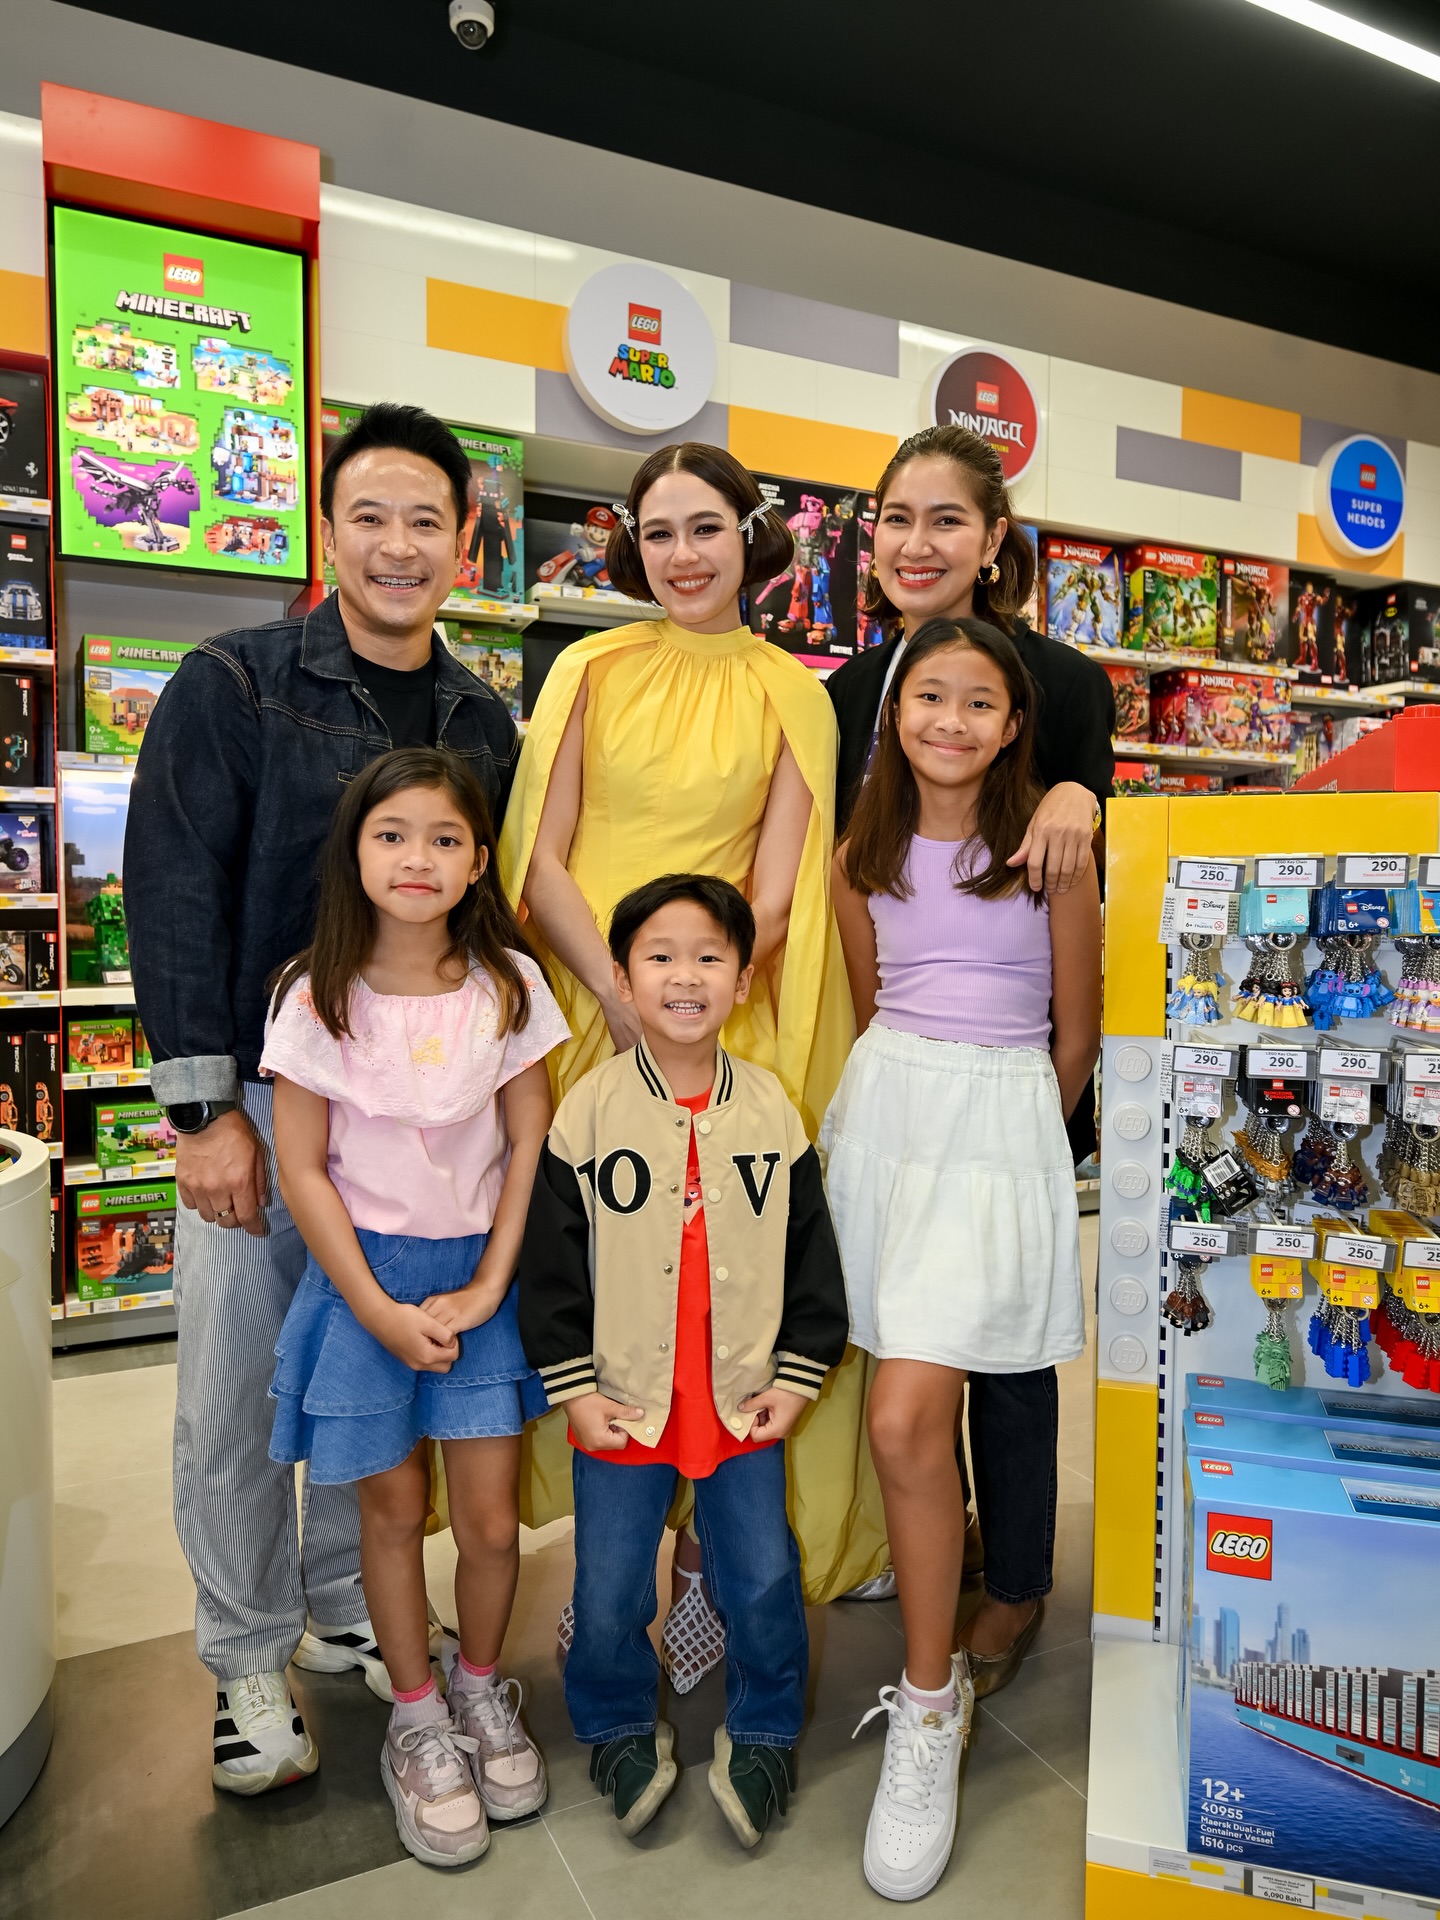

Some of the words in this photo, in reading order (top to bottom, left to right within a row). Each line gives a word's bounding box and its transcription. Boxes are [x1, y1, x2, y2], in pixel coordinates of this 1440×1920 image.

[167, 266, 200, 284] LEGO
[115, 290, 251, 333] MINECRAFT
[632, 315, 659, 332] LEGO
[618, 344, 669, 368] SUPER
[608, 356, 676, 389] MARIO
[978, 391, 998, 404] LEGO
[948, 408, 1026, 448] NINJAGO
[1361, 471, 1376, 482] LEGO
[1352, 498, 1382, 514] SUPER
[1347, 512, 1385, 529] HEROES
[1064, 544, 1102, 564] NINJAGO
[1158, 551, 1196, 569] NINJAGO
[1236, 562, 1269, 580] NINJAGO
[90, 645, 110, 655] LEGO
[116, 646, 186, 662] MINECRAF
[1200, 674, 1236, 690] NINJAGO
[90, 726, 101, 734] 9+
[1279, 865, 1303, 875] 290
[1372, 861, 1397, 871] 290
[1200, 870, 1224, 881] 250
[1200, 899, 1225, 911] Disney
[1359, 903, 1385, 912] Disney
[1118, 1056, 1147, 1074] LEGO
[1194, 1054, 1218, 1065] 290
[1269, 1057, 1294, 1067] 290
[1341, 1057, 1366, 1068] 290
[118, 1109, 164, 1119] MINECRAFT
[1118, 1115, 1146, 1132] LEGO
[596, 1147, 652, 1216] O
[731, 1150, 783, 1218] V
[1117, 1173, 1146, 1191] LEGO
[81, 1200, 99, 1208] LEGO
[105, 1192, 167, 1206] MINECRAFT
[1116, 1231, 1144, 1249] LEGO
[1193, 1236, 1216, 1247] 250
[1276, 1237, 1301, 1248] 250
[1348, 1247, 1373, 1260] 250
[1114, 1290, 1143, 1308] LEGO
[1113, 1347, 1142, 1365] LEGO
[1204, 1463, 1231, 1472] LEGO
[1212, 1532, 1267, 1560] LEGO
[1202, 1778, 1245, 1802] 12+
[1201, 1802, 1243, 1820] 40955
[1200, 1824, 1242, 1838] Container
[1245, 1834, 1273, 1844] Vessel
[1201, 1816, 1231, 1829] Maersk
[1233, 1824, 1275, 1837] Dual-Fuel
[1200, 1836, 1224, 1849] 1516
[1227, 1843, 1244, 1853] pcs
[1264, 1891, 1284, 1900] 6,090
